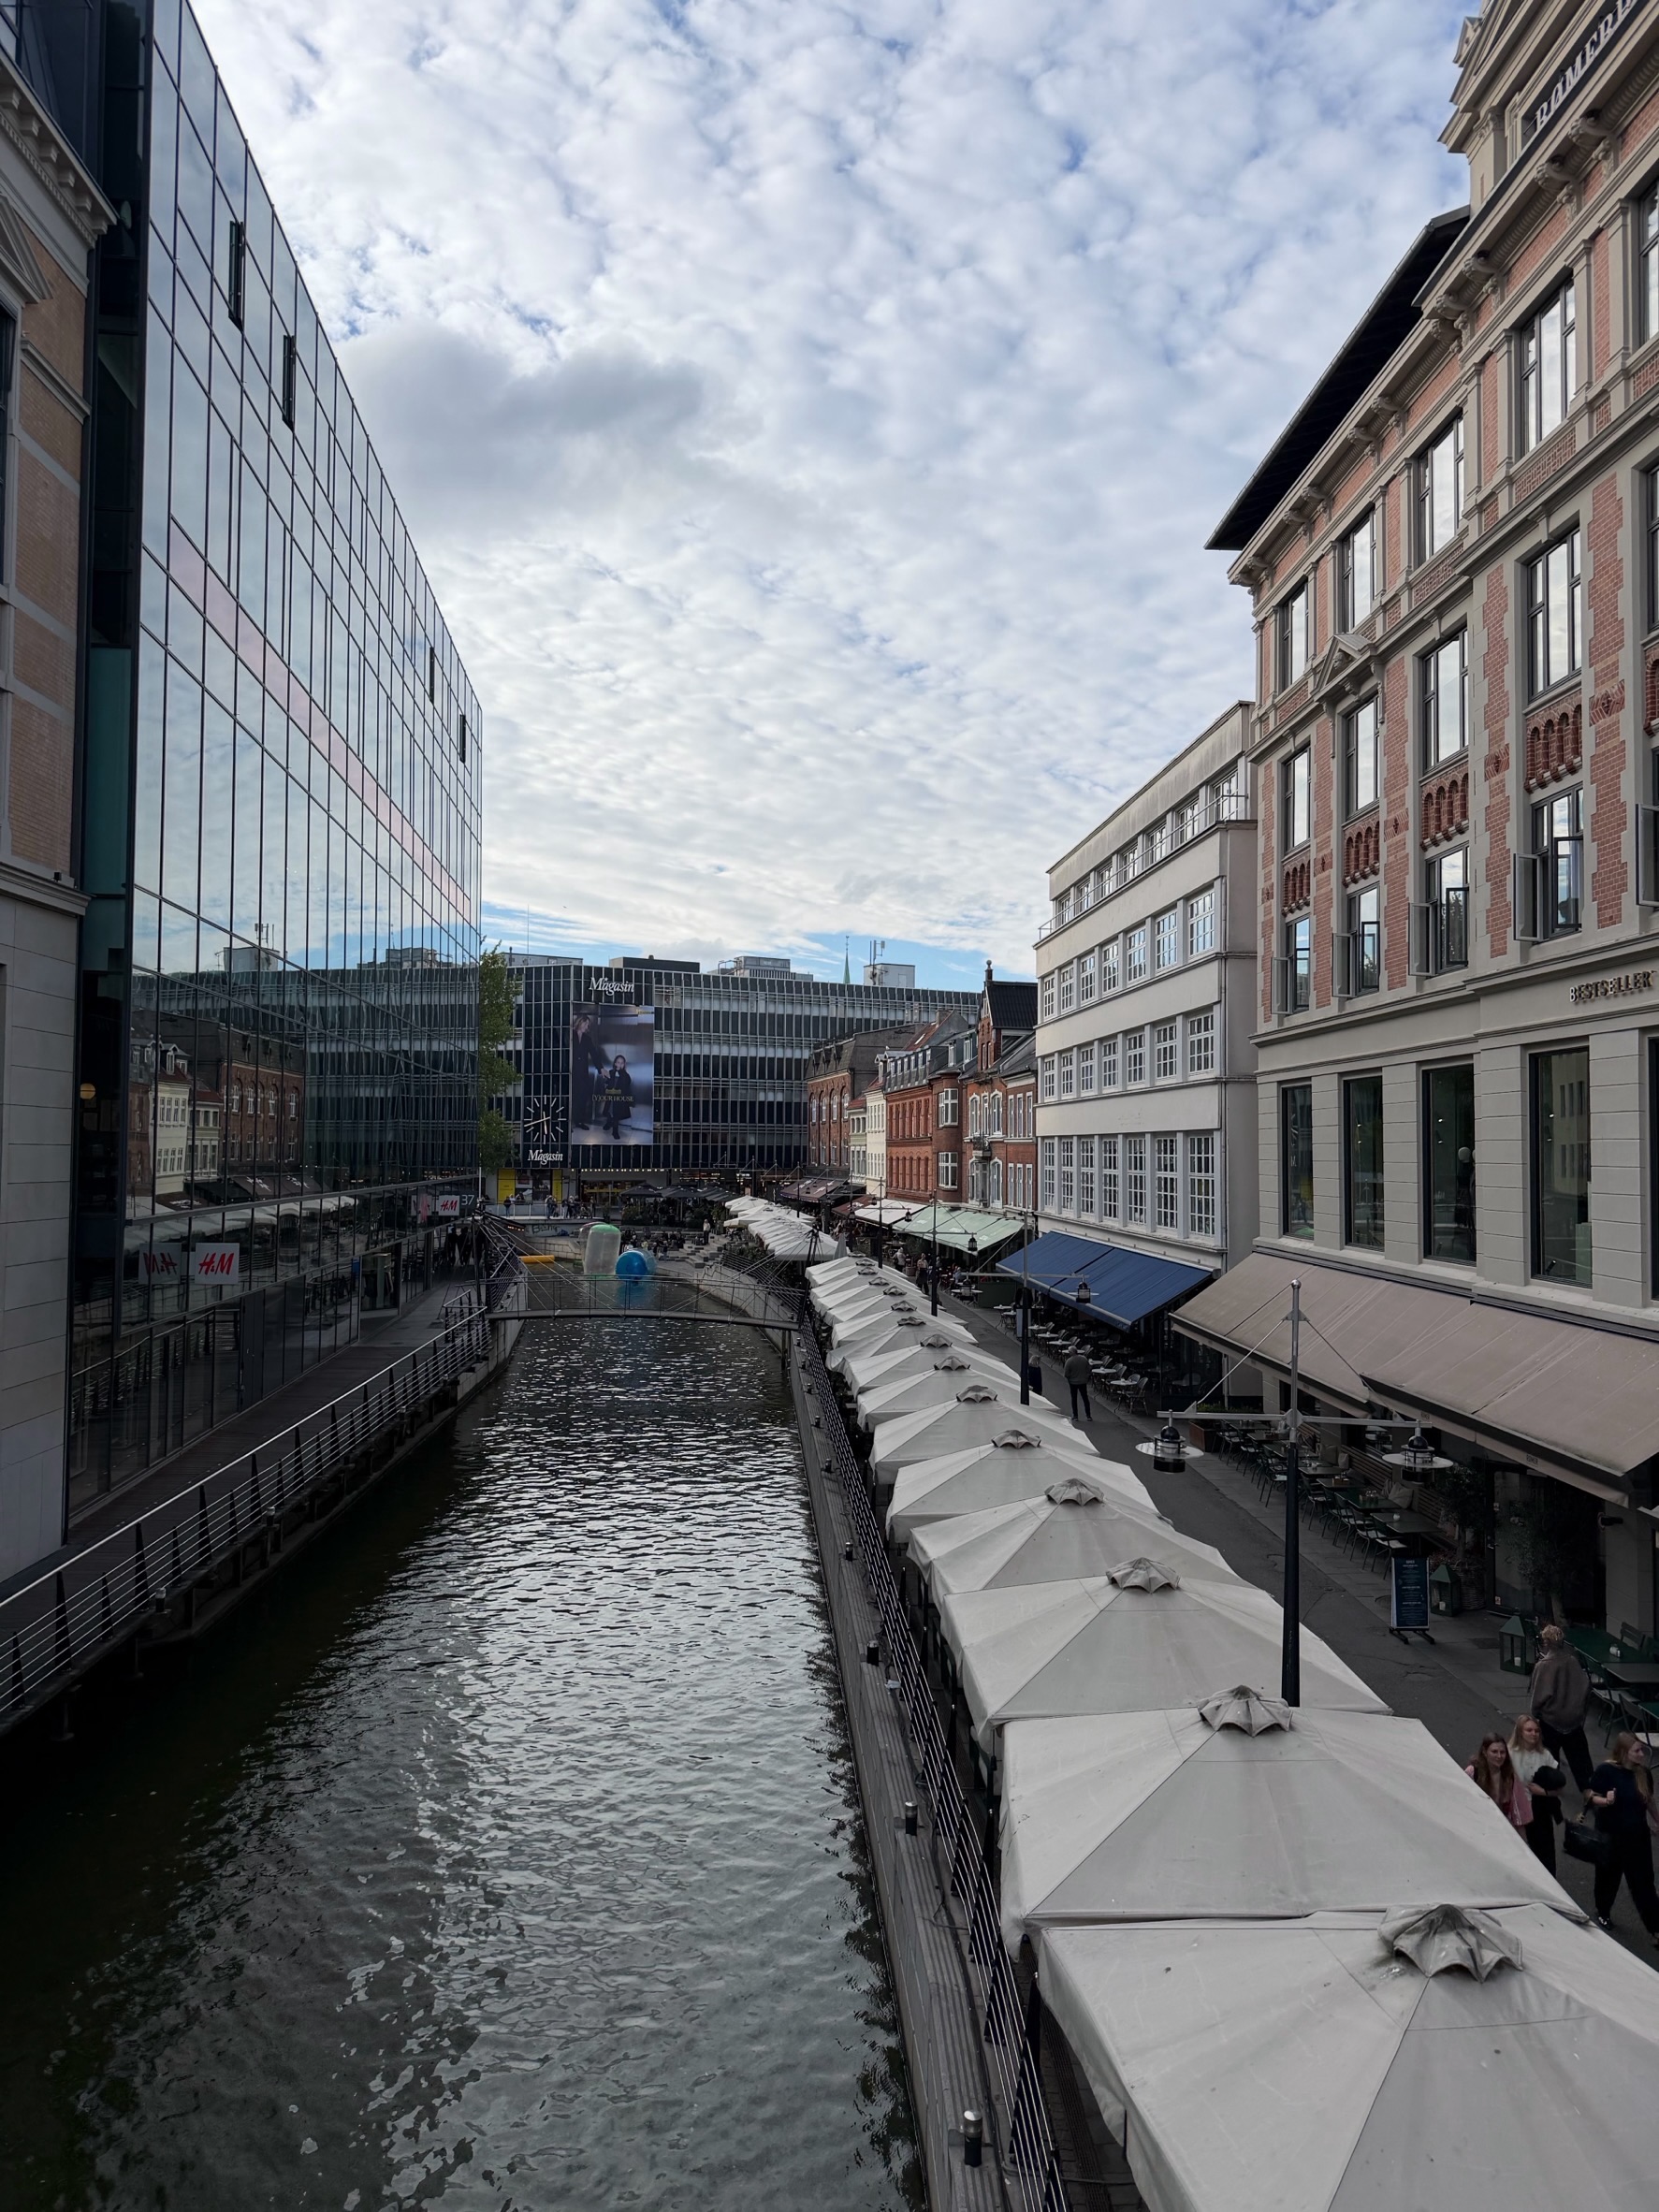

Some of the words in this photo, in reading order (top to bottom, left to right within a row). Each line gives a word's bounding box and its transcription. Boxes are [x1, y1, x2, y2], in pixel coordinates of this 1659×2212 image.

[588, 977, 634, 997] Magasin
[1569, 971, 1653, 1002] BESTSELLER
[527, 1149, 563, 1166] Magasin
[440, 1200, 458, 1212] H&M
[460, 1194, 475, 1206] 37
[198, 1252, 235, 1276] H&M
